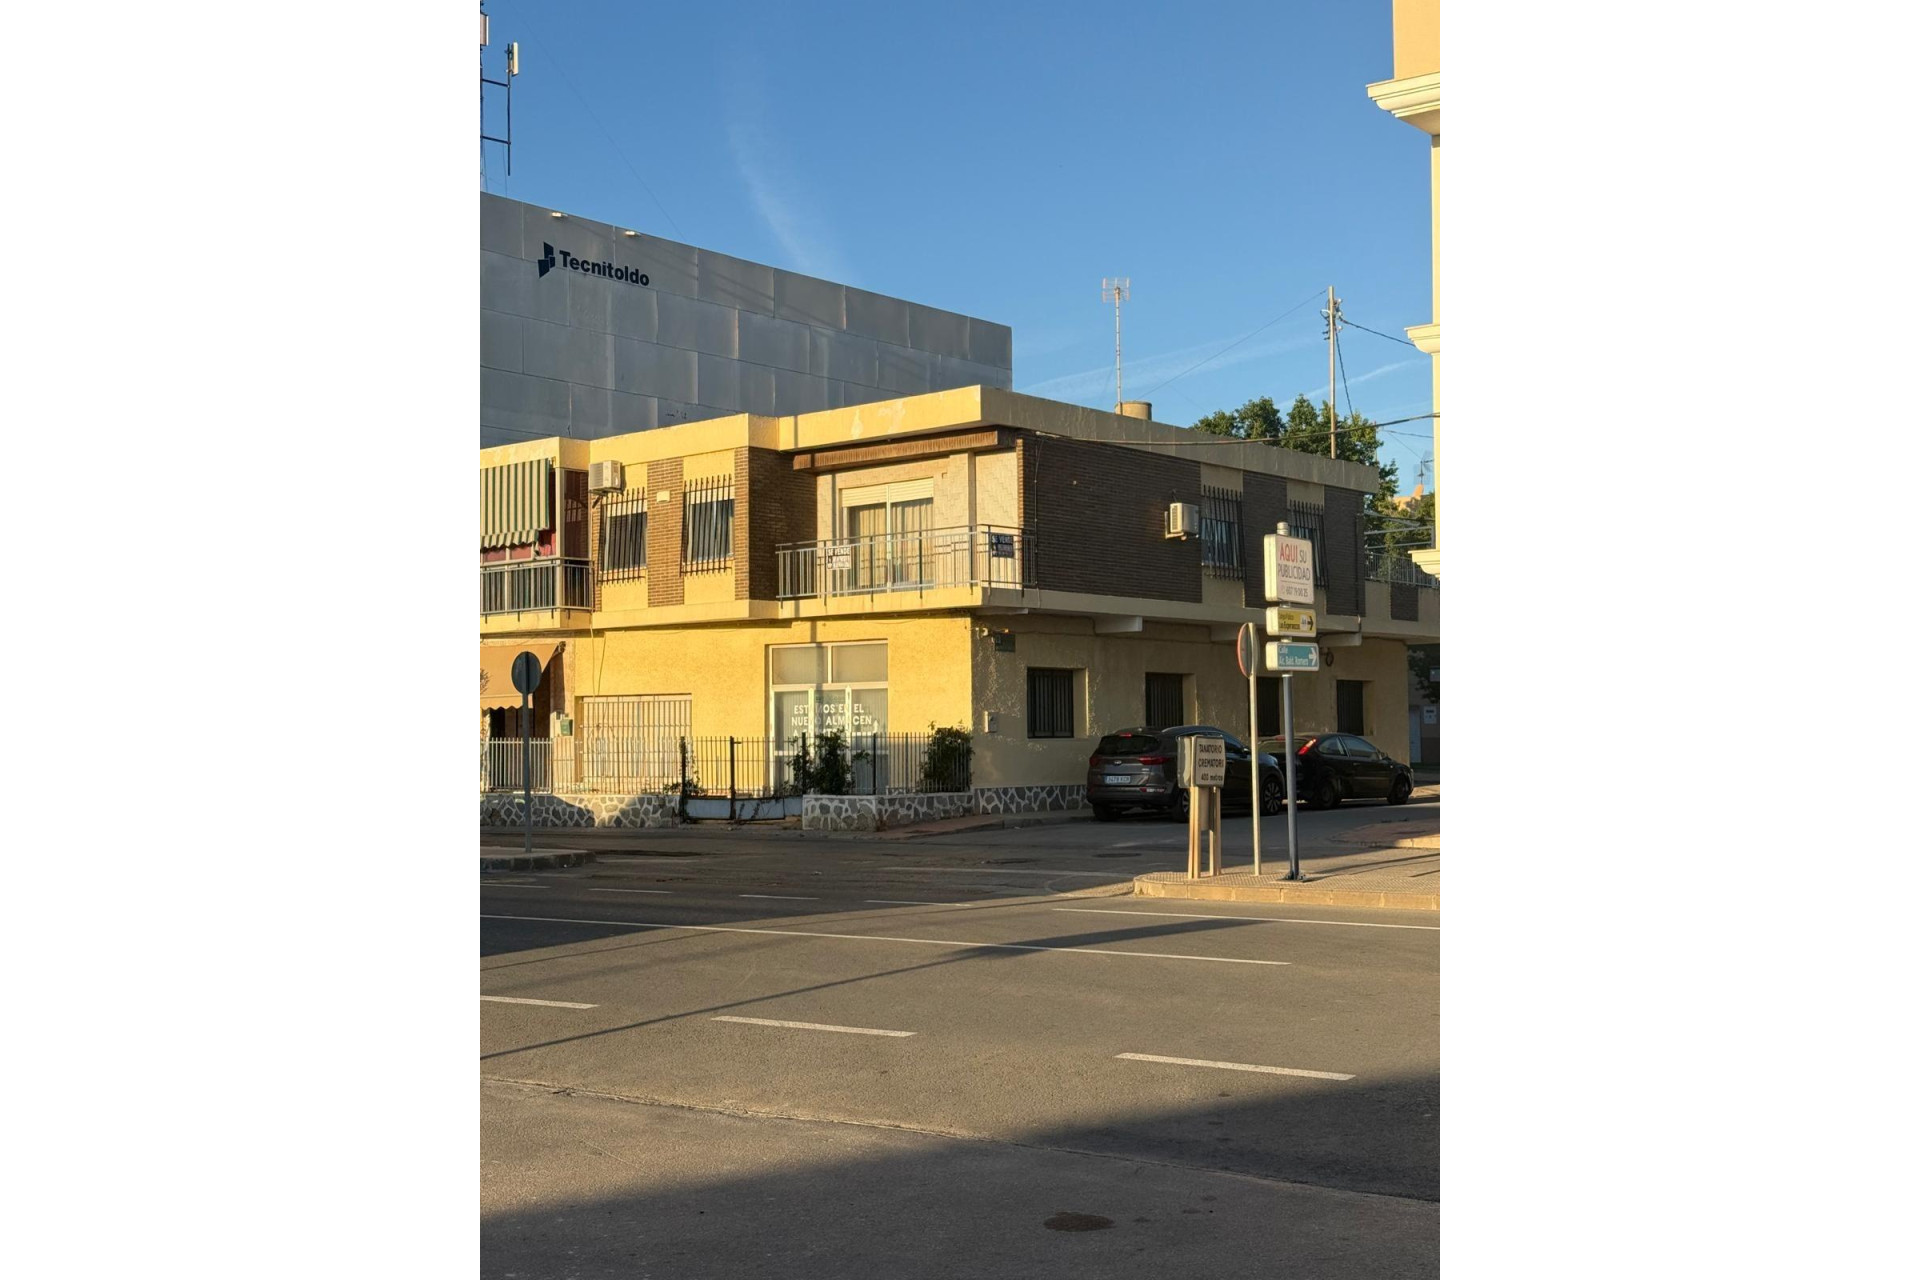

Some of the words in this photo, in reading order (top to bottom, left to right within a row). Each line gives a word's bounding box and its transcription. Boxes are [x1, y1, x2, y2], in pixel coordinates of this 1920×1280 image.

[559, 250, 650, 286] Tecnitoldo
[1300, 550, 1307, 563] SU
[1278, 564, 1311, 581] PUBLICIDAD
[854, 704, 864, 713] EL
[791, 716, 822, 726] NUEO
[826, 715, 872, 726] ALMCEN
[1199, 744, 1223, 753] TANATORIO
